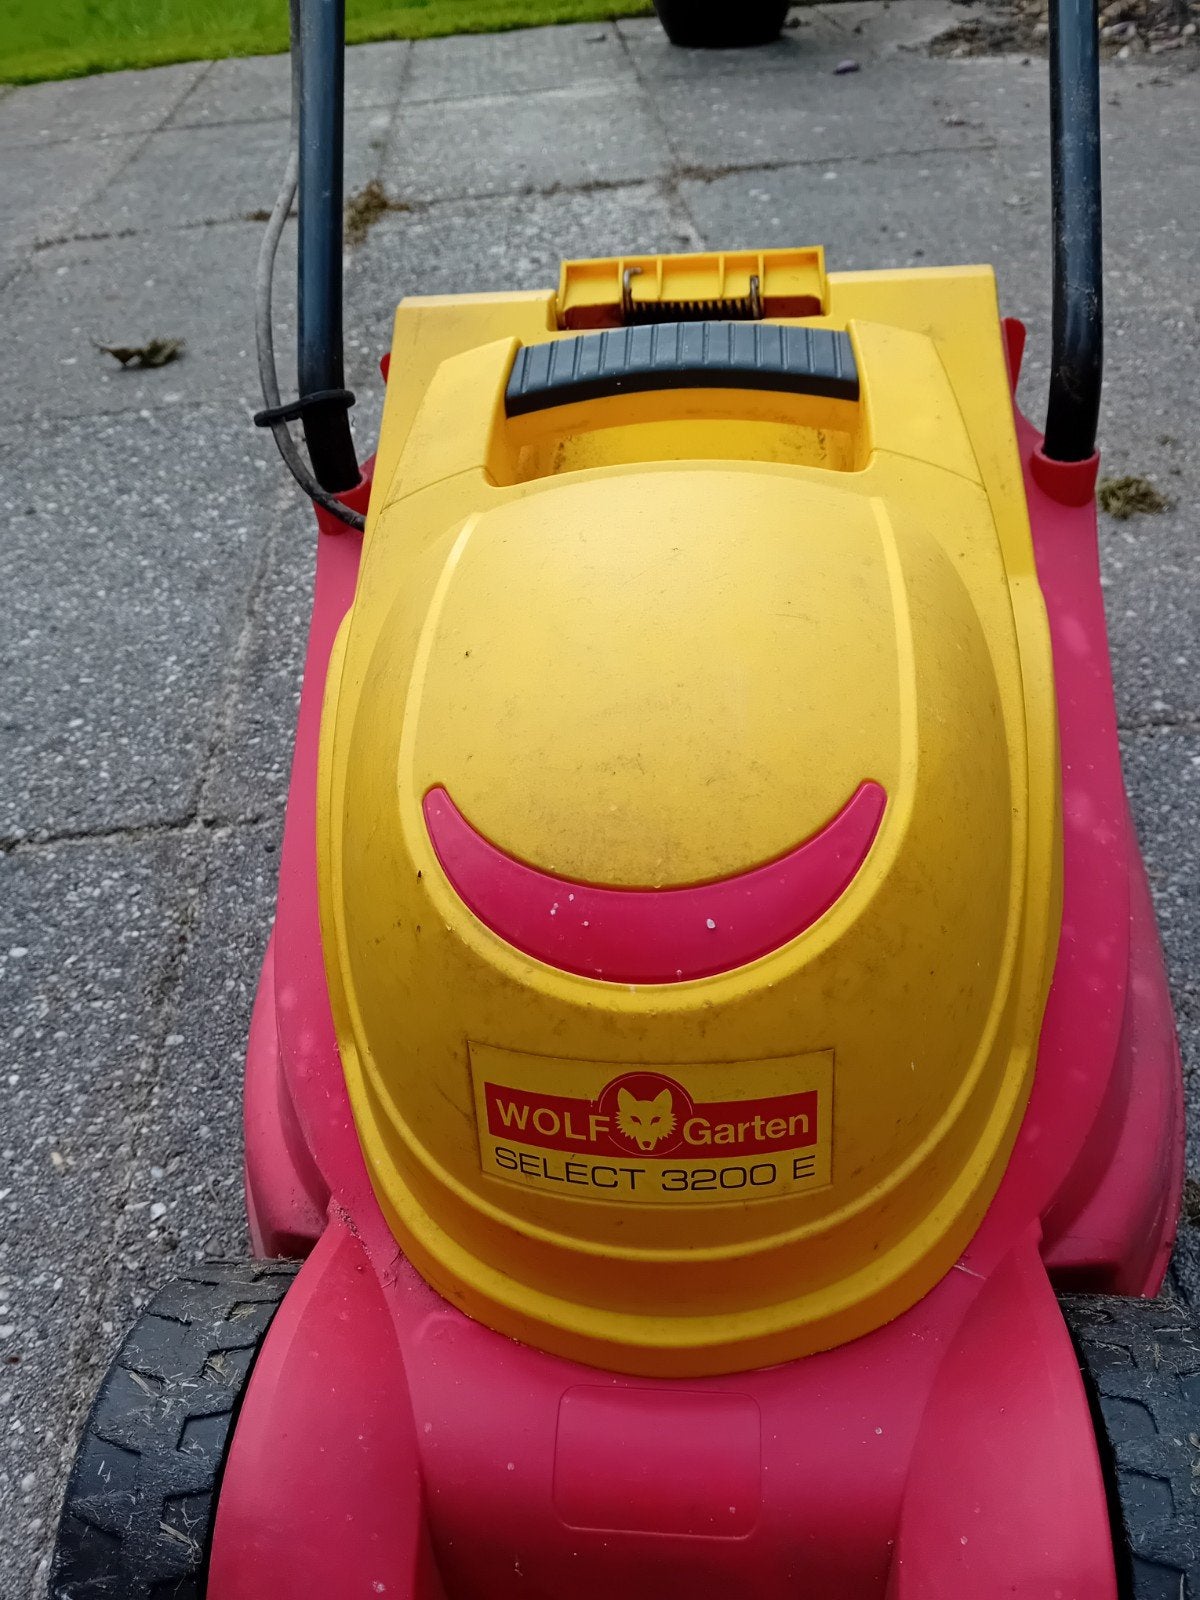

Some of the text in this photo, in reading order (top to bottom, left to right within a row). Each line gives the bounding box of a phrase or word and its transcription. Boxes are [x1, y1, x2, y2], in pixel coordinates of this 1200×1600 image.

[495, 1098, 809, 1146] WOLF Garten
[494, 1146, 816, 1192] SELECT 3200 E
